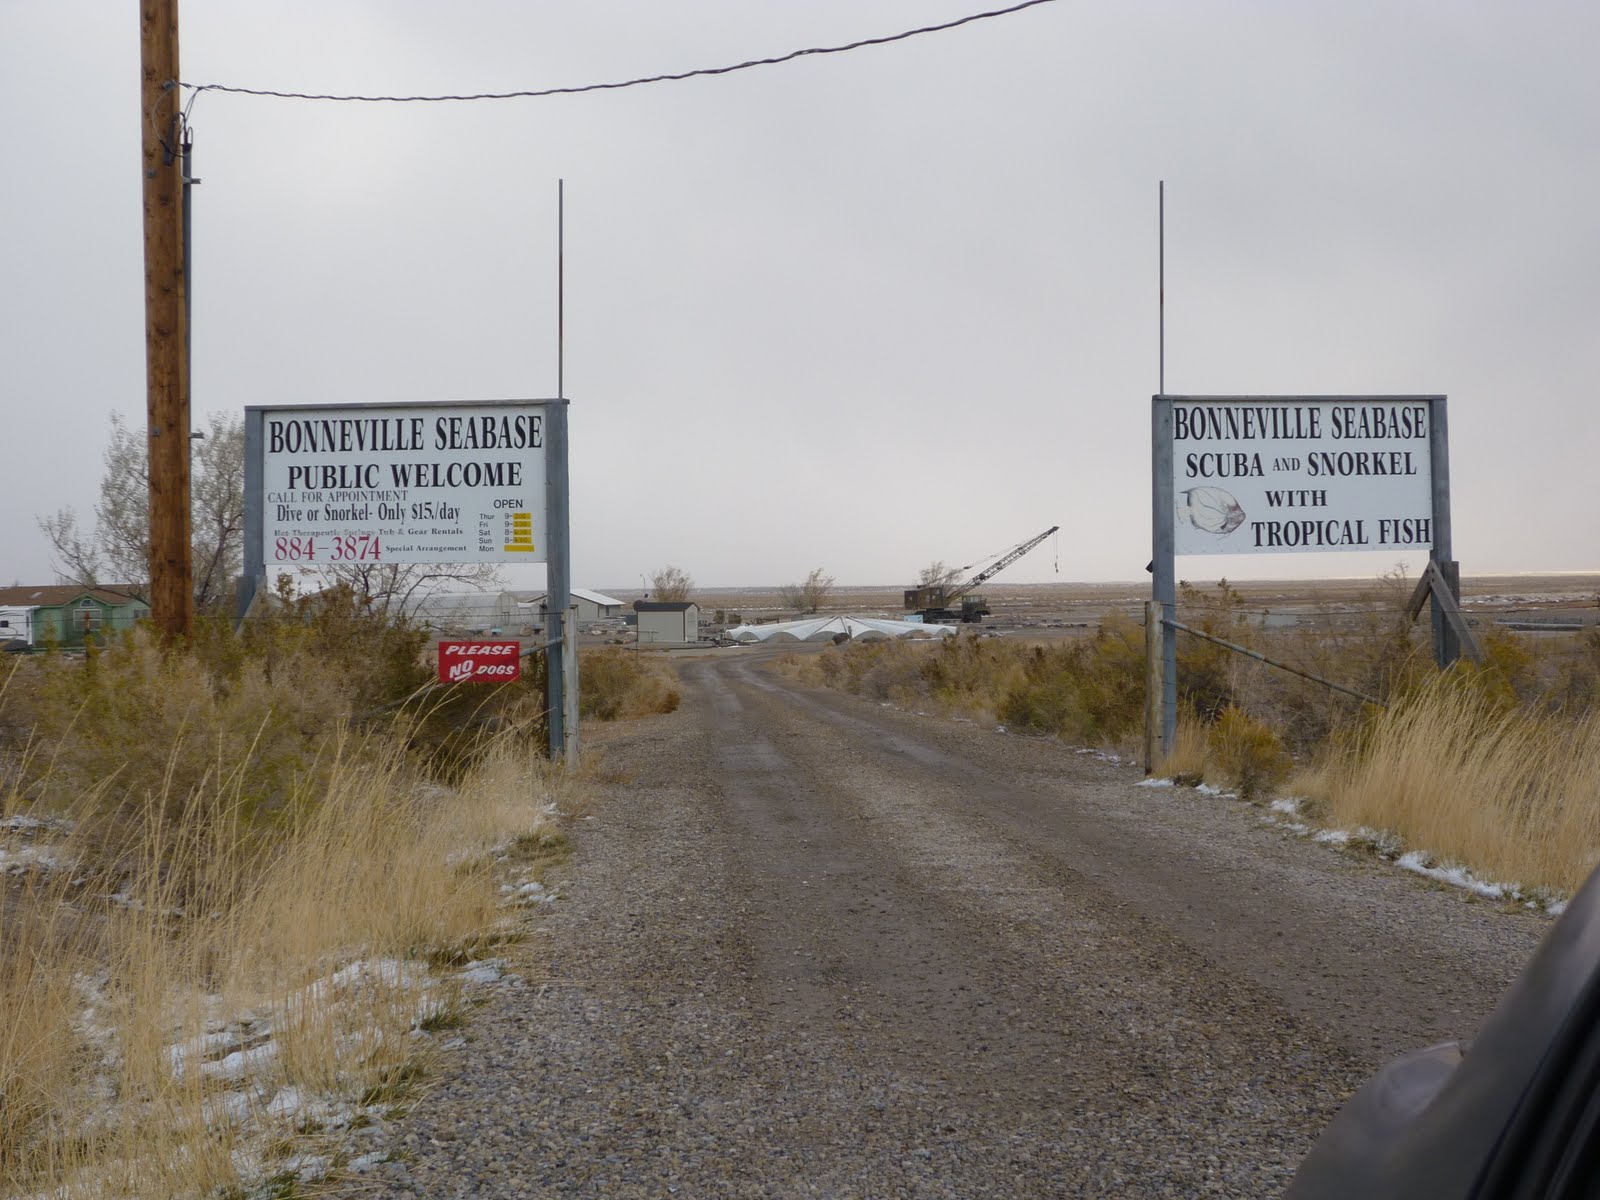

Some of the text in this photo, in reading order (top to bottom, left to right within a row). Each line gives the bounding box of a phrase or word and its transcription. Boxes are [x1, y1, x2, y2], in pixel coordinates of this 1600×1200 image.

[269, 415, 542, 453] BONNEVILLE SEABASE
[1174, 406, 1426, 440] BONNEVILLE SEABASE
[288, 462, 522, 489] PUBLIC WELCOME
[1186, 451, 1417, 478] SCUBA AND SNORKEL
[268, 490, 408, 503] CALL FOR APPOINTMENT
[493, 499, 523, 509] OPEN
[1265, 490, 1328, 507] WITH
[276, 504, 302, 521] Dive
[307, 508, 319, 521] or
[378, 502, 406, 524] Only
[1251, 518, 1431, 547] TROPICAL FISH
[274, 536, 381, 560] 884-3874
[385, 545, 467, 553] Special Arrangement
[445, 645, 516, 655] PLEASE
[449, 659, 515, 679] NO DOGS
